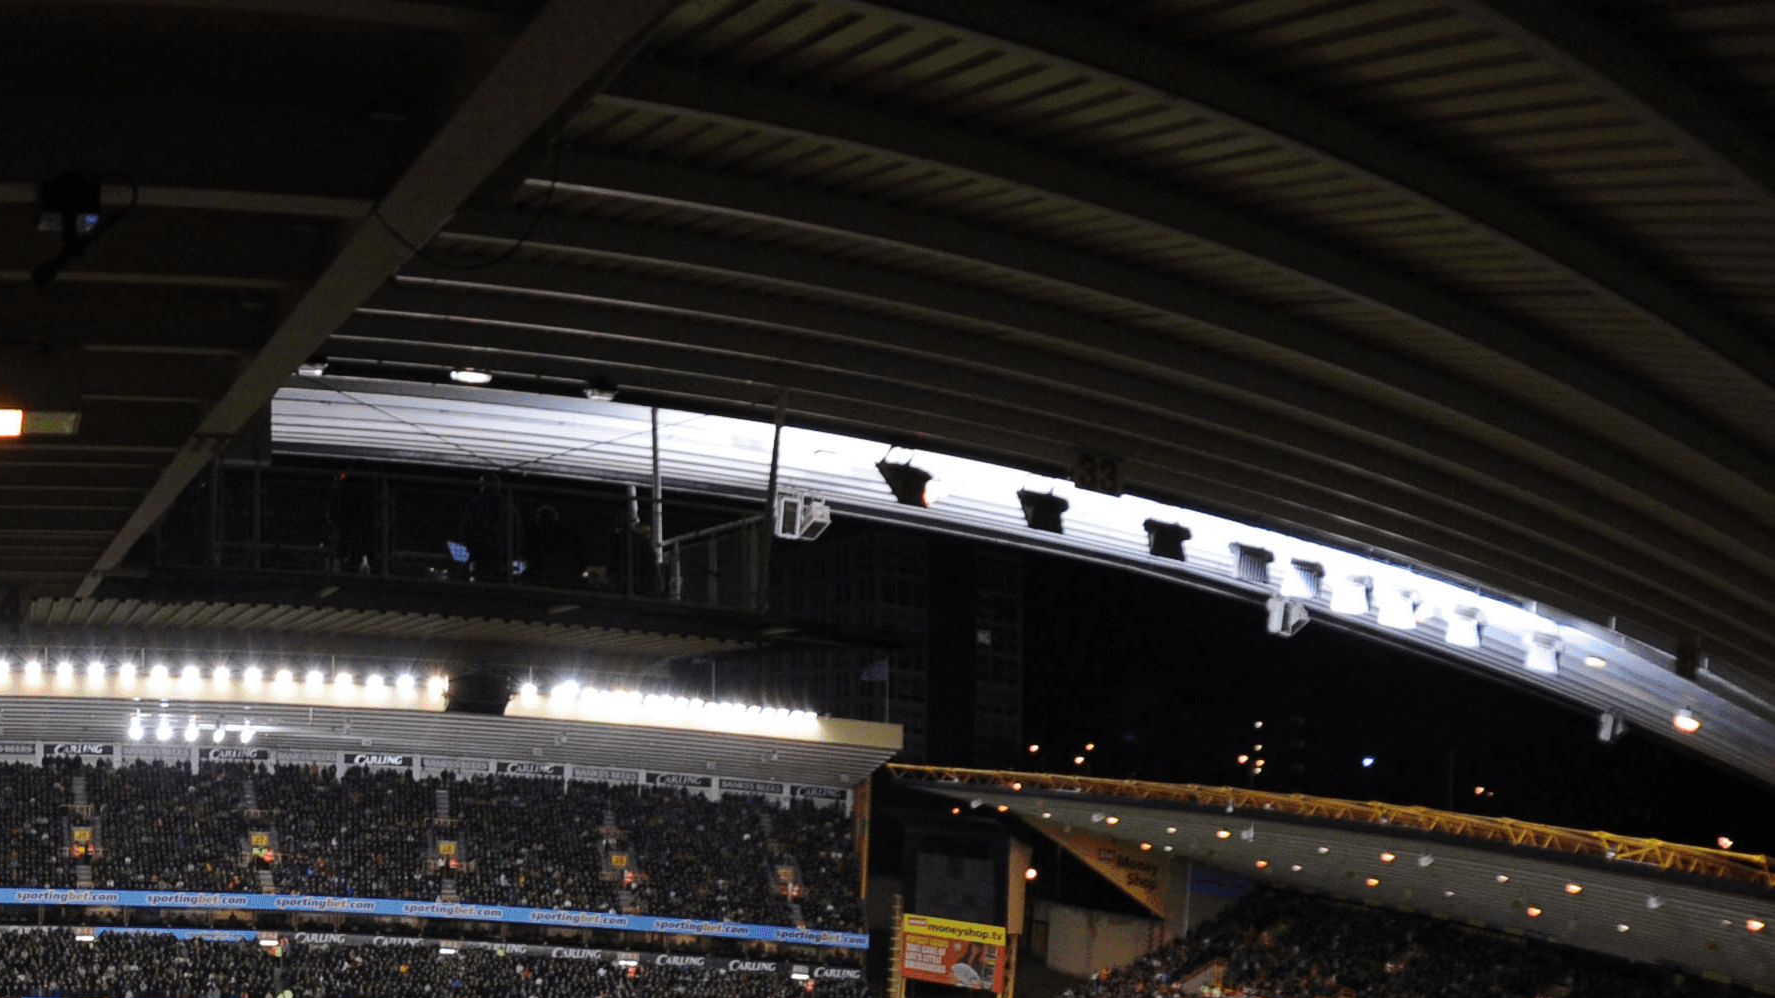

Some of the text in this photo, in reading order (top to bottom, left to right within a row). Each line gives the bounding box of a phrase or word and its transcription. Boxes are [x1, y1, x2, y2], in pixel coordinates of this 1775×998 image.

[54, 744, 103, 755] CARLING
[354, 754, 403, 766] CARLING
[16, 890, 118, 903] sportingbet.com
[147, 894, 246, 906] sportingbet.com
[276, 897, 375, 911] sportingbet.com
[404, 903, 502, 917] sportingbet.com
[531, 910, 627, 925] sportingbet.com
[655, 919, 749, 934] sportingbet.com
[295, 932, 346, 944] CARLING
[775, 929, 866, 944] sportingbet.com
[552, 946, 602, 959] CARLING
[656, 954, 705, 967] CARLING
[729, 959, 777, 972] CARLING
[813, 966, 861, 980] CARLING
